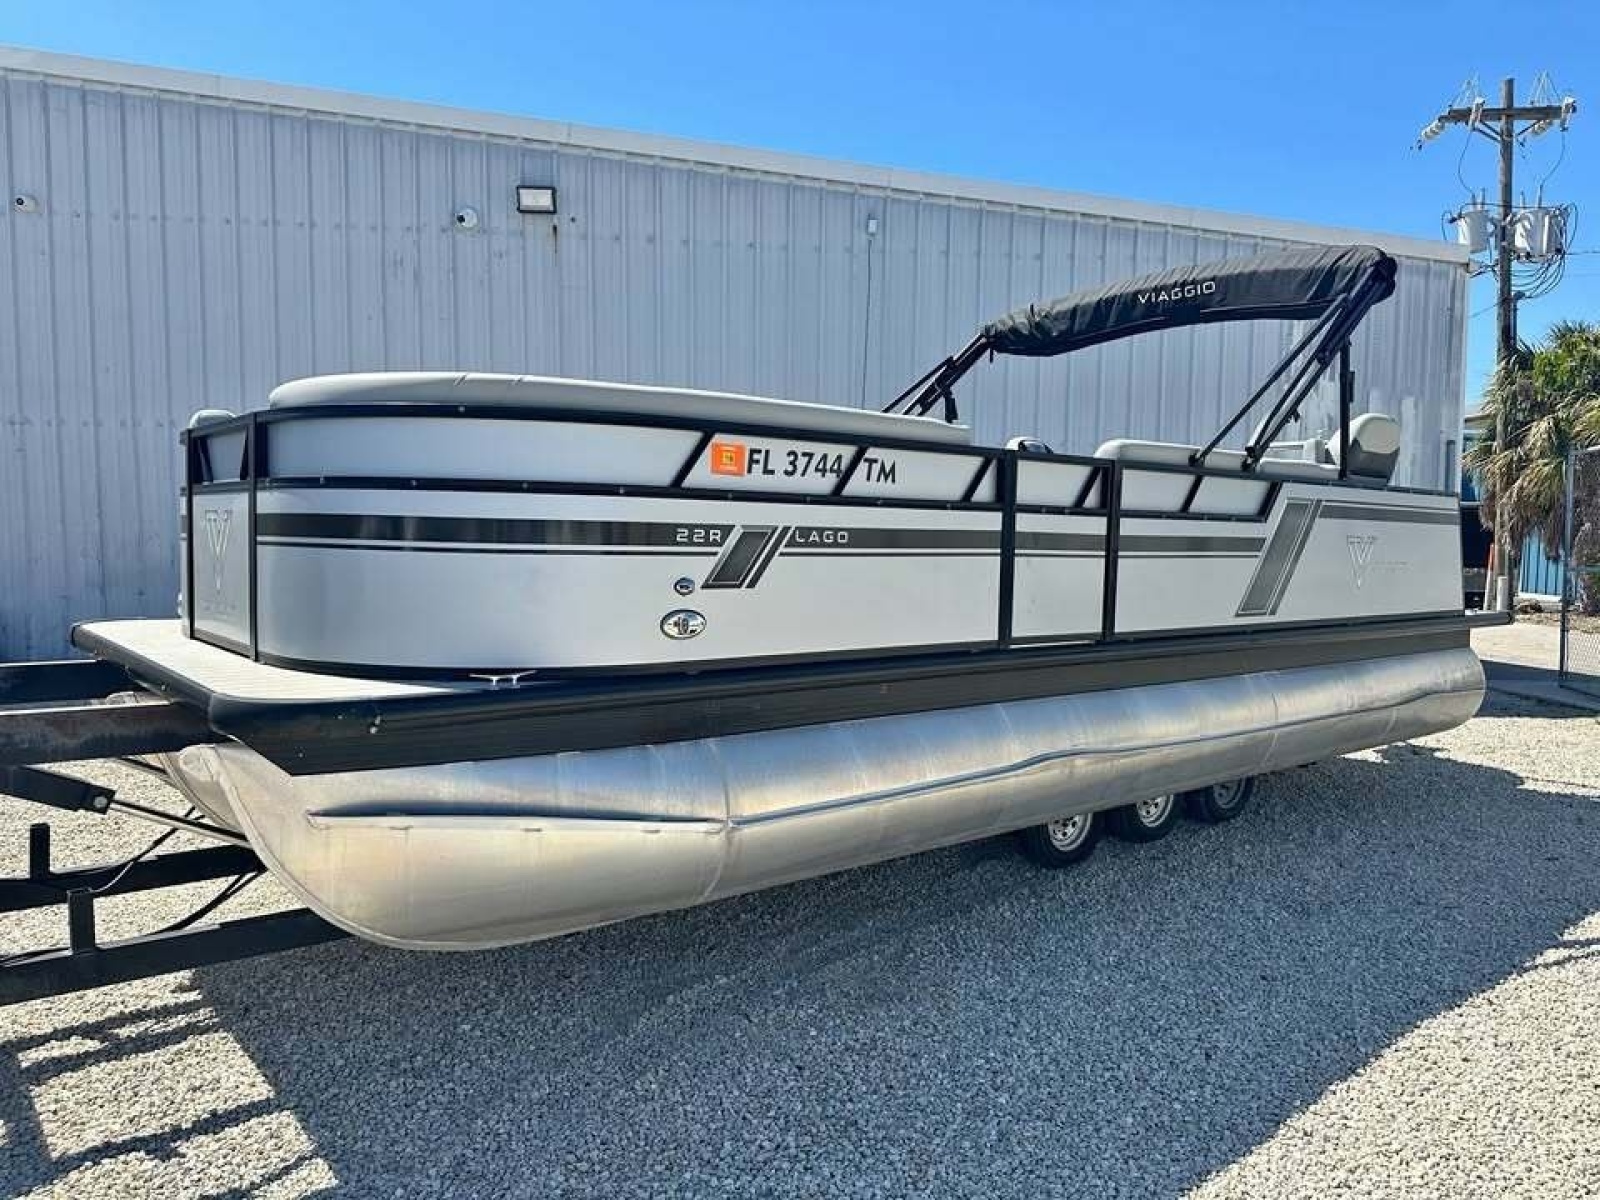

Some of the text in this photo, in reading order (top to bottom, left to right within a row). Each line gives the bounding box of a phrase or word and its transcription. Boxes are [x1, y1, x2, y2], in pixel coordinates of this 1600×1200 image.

[1137, 281, 1216, 304] VIAGGIO
[747, 447, 776, 476] FL
[783, 450, 843, 479] 3744
[863, 457, 896, 484] TM
[676, 527, 849, 543] 22R LAGO
